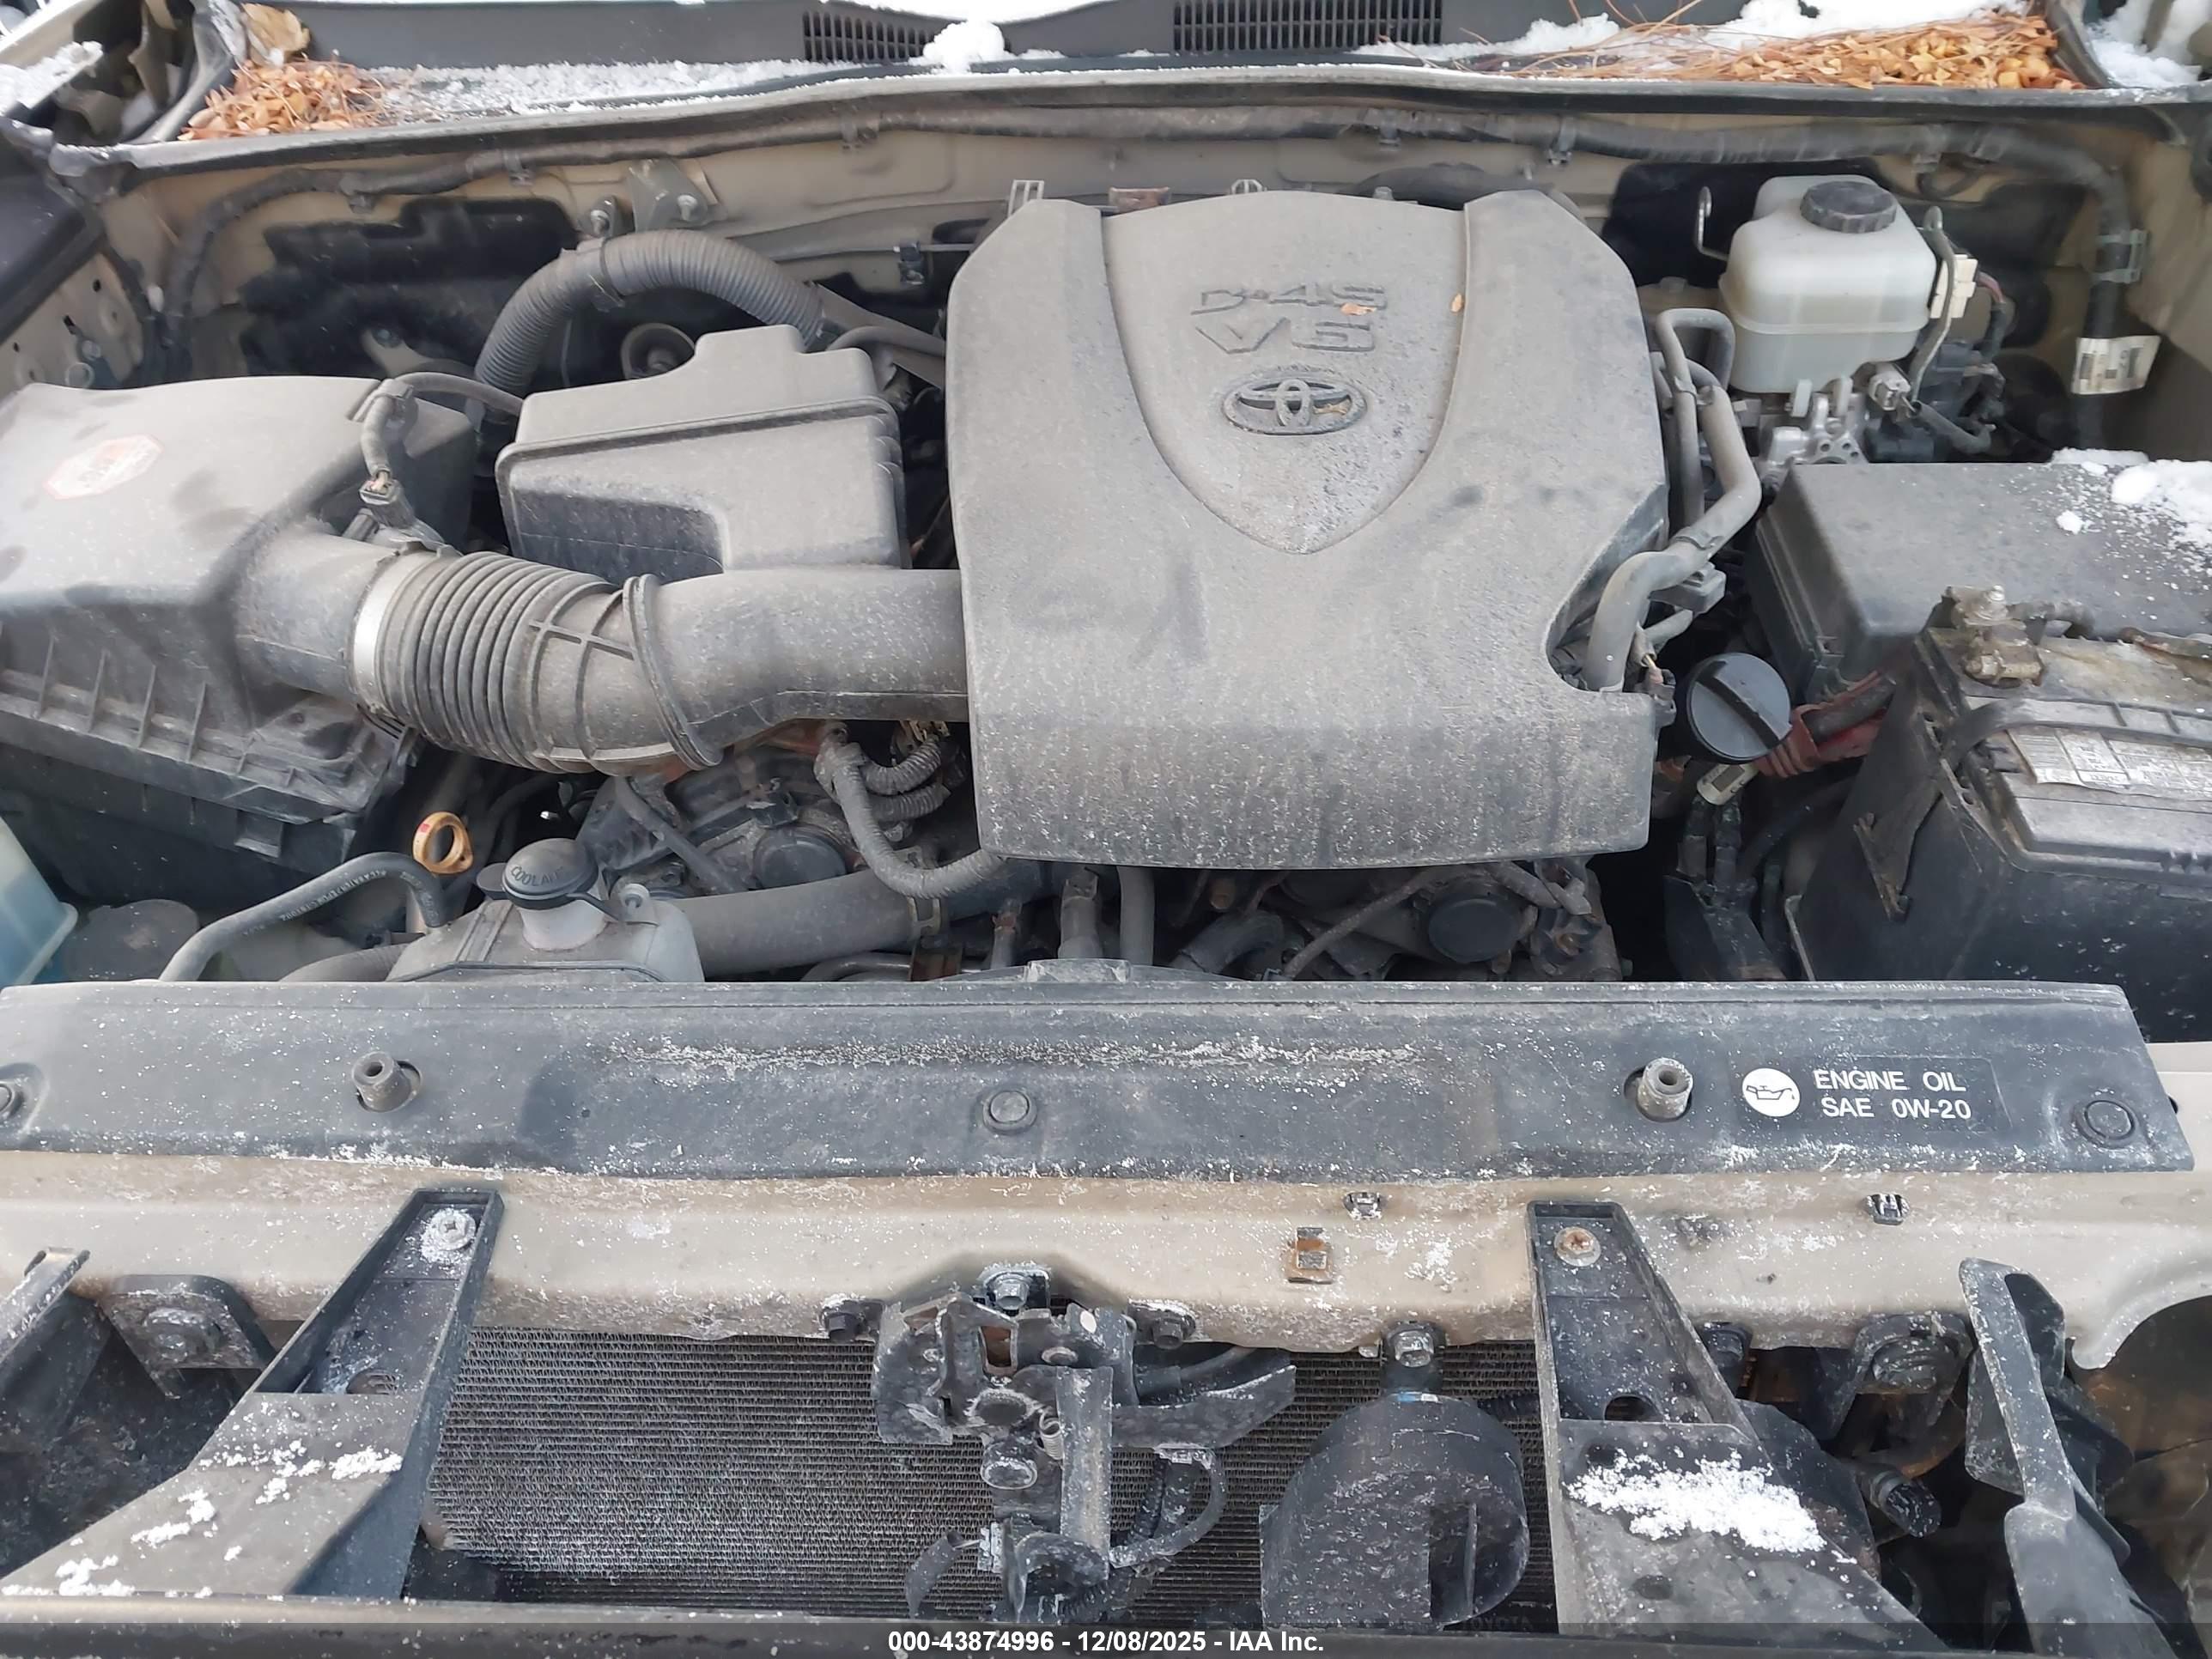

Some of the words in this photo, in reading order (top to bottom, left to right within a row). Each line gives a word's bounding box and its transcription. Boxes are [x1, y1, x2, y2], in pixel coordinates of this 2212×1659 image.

[1814, 1068, 1910, 1091] ENGINE
[1922, 1070, 1966, 1092] OIL
[1820, 1097, 1875, 1118] SAE
[1891, 1098, 1972, 1120] 0W-20
